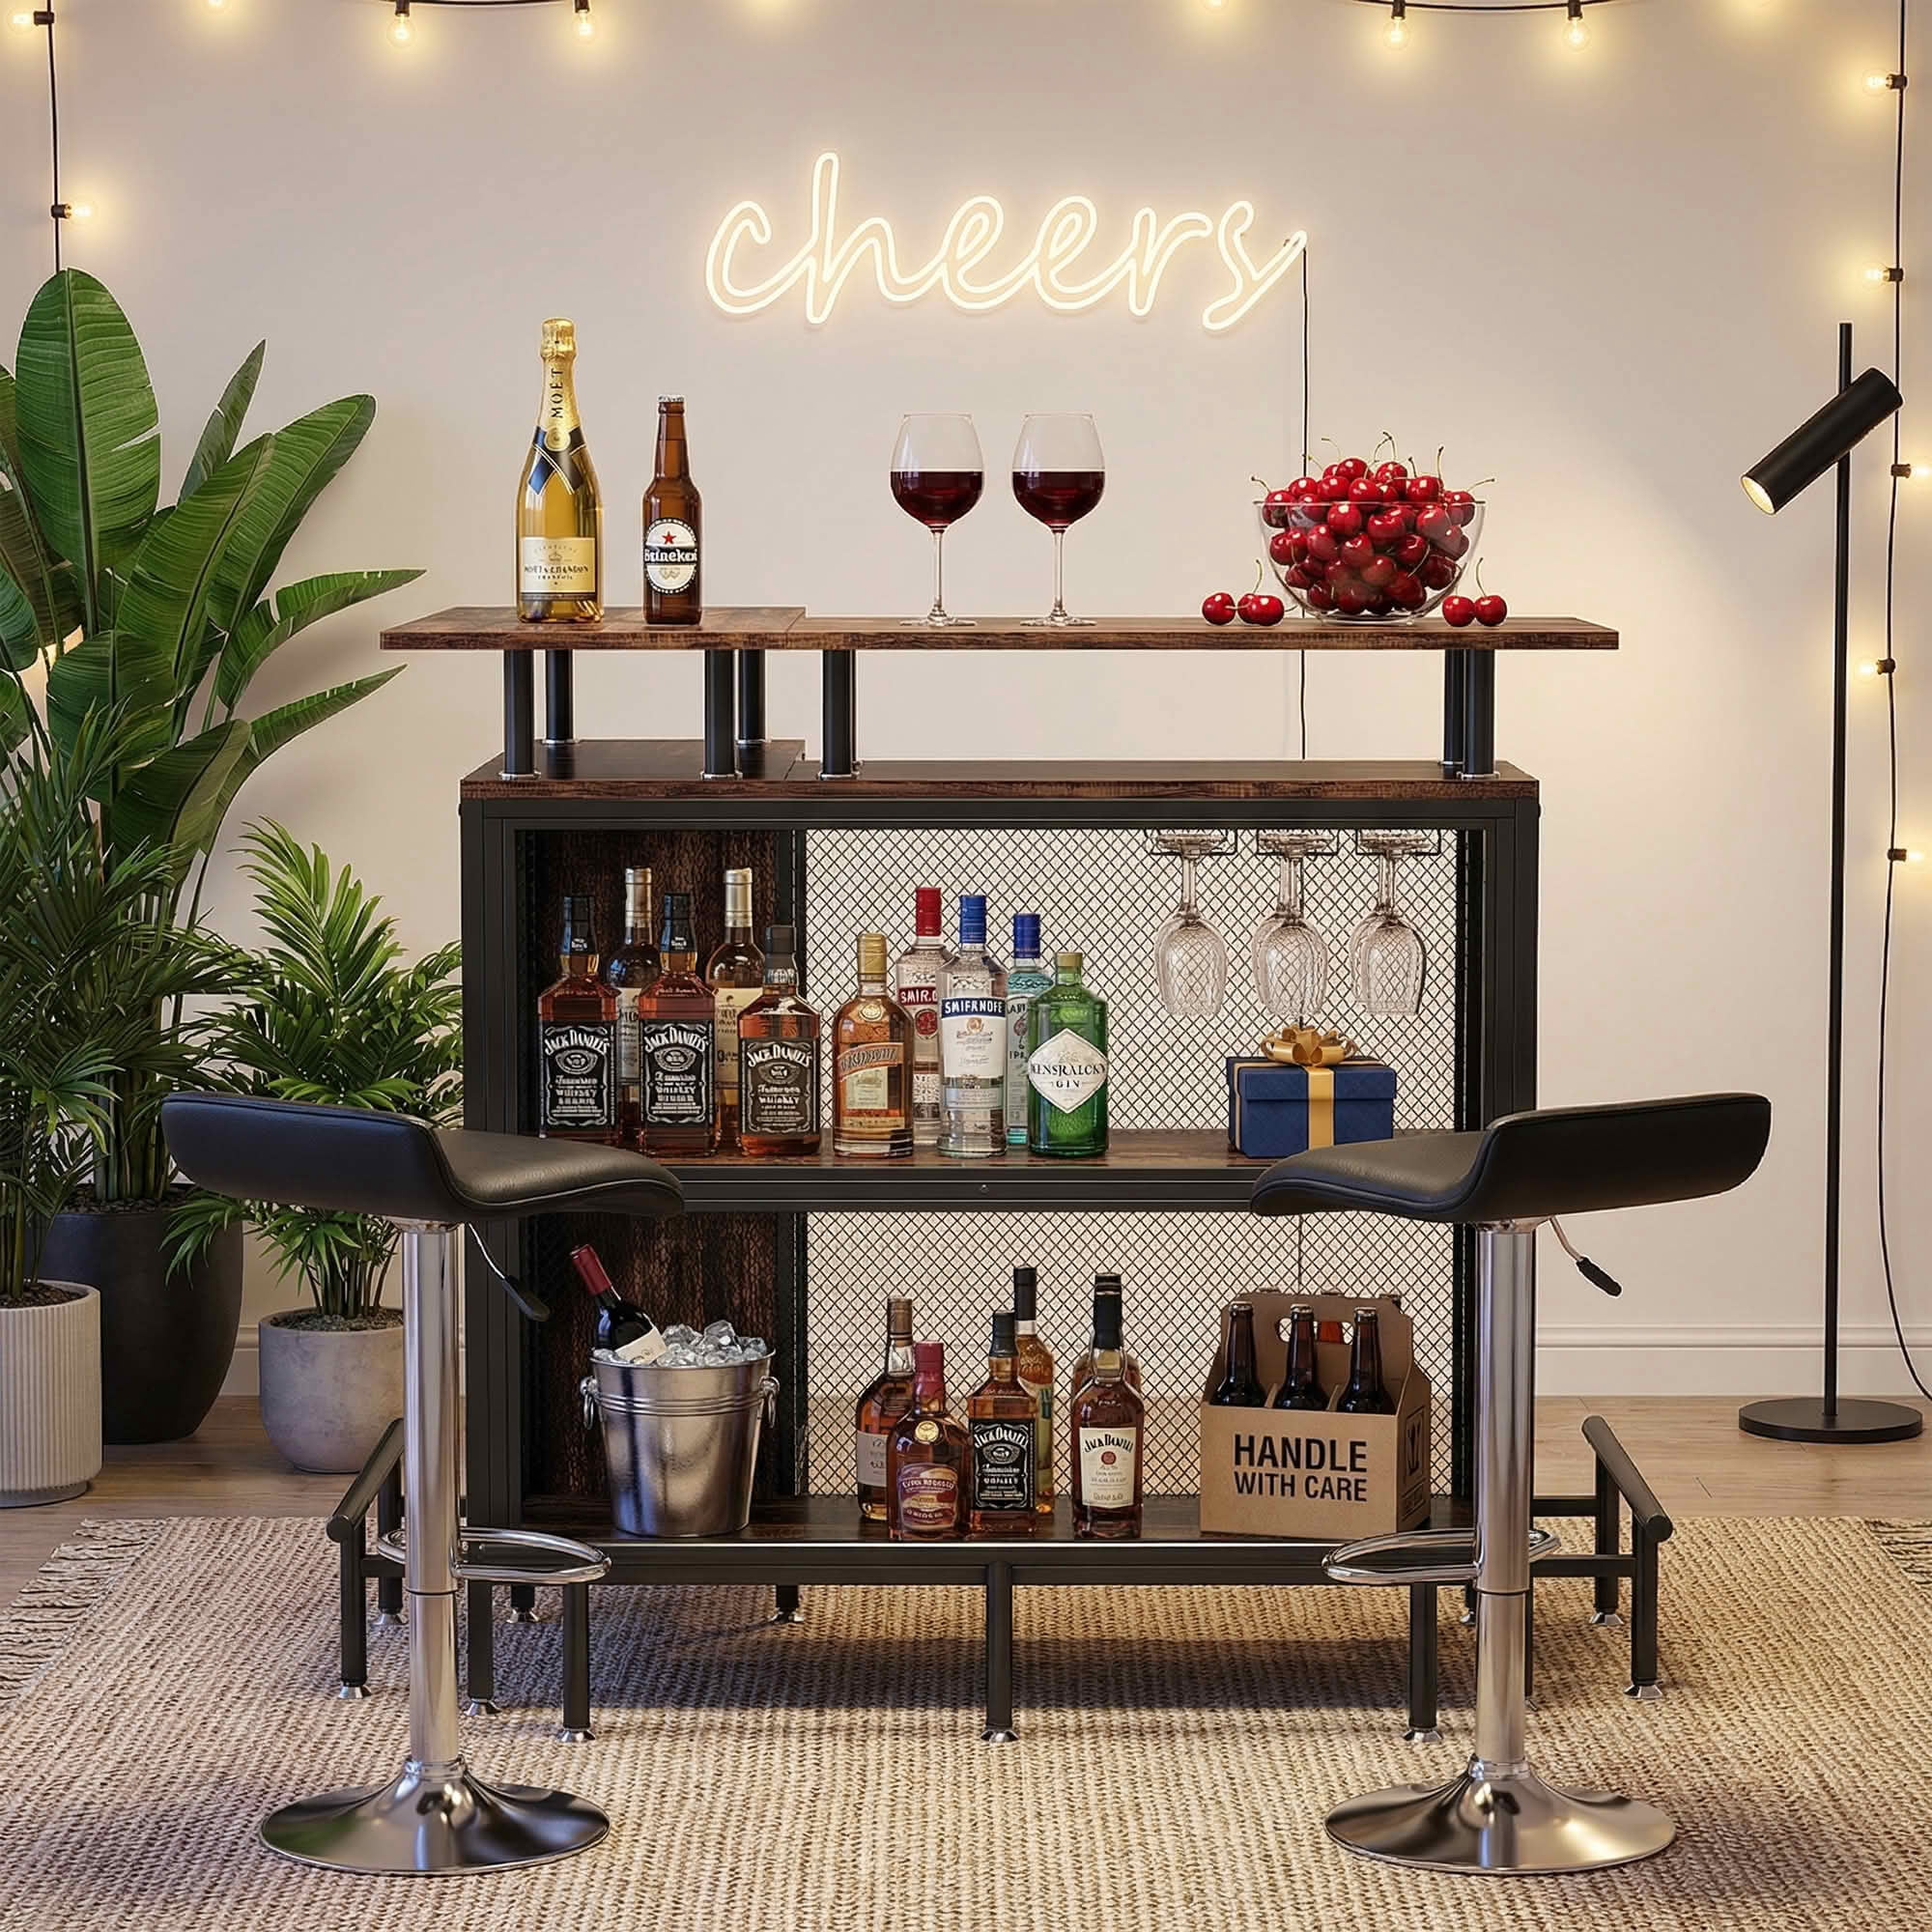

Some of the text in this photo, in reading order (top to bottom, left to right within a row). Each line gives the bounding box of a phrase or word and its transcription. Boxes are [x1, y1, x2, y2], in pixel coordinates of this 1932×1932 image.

[705, 151, 1308, 331] cheers
[1234, 1434, 1368, 1473] HANDLE
[1234, 1471, 1368, 1502] WITH CARE
